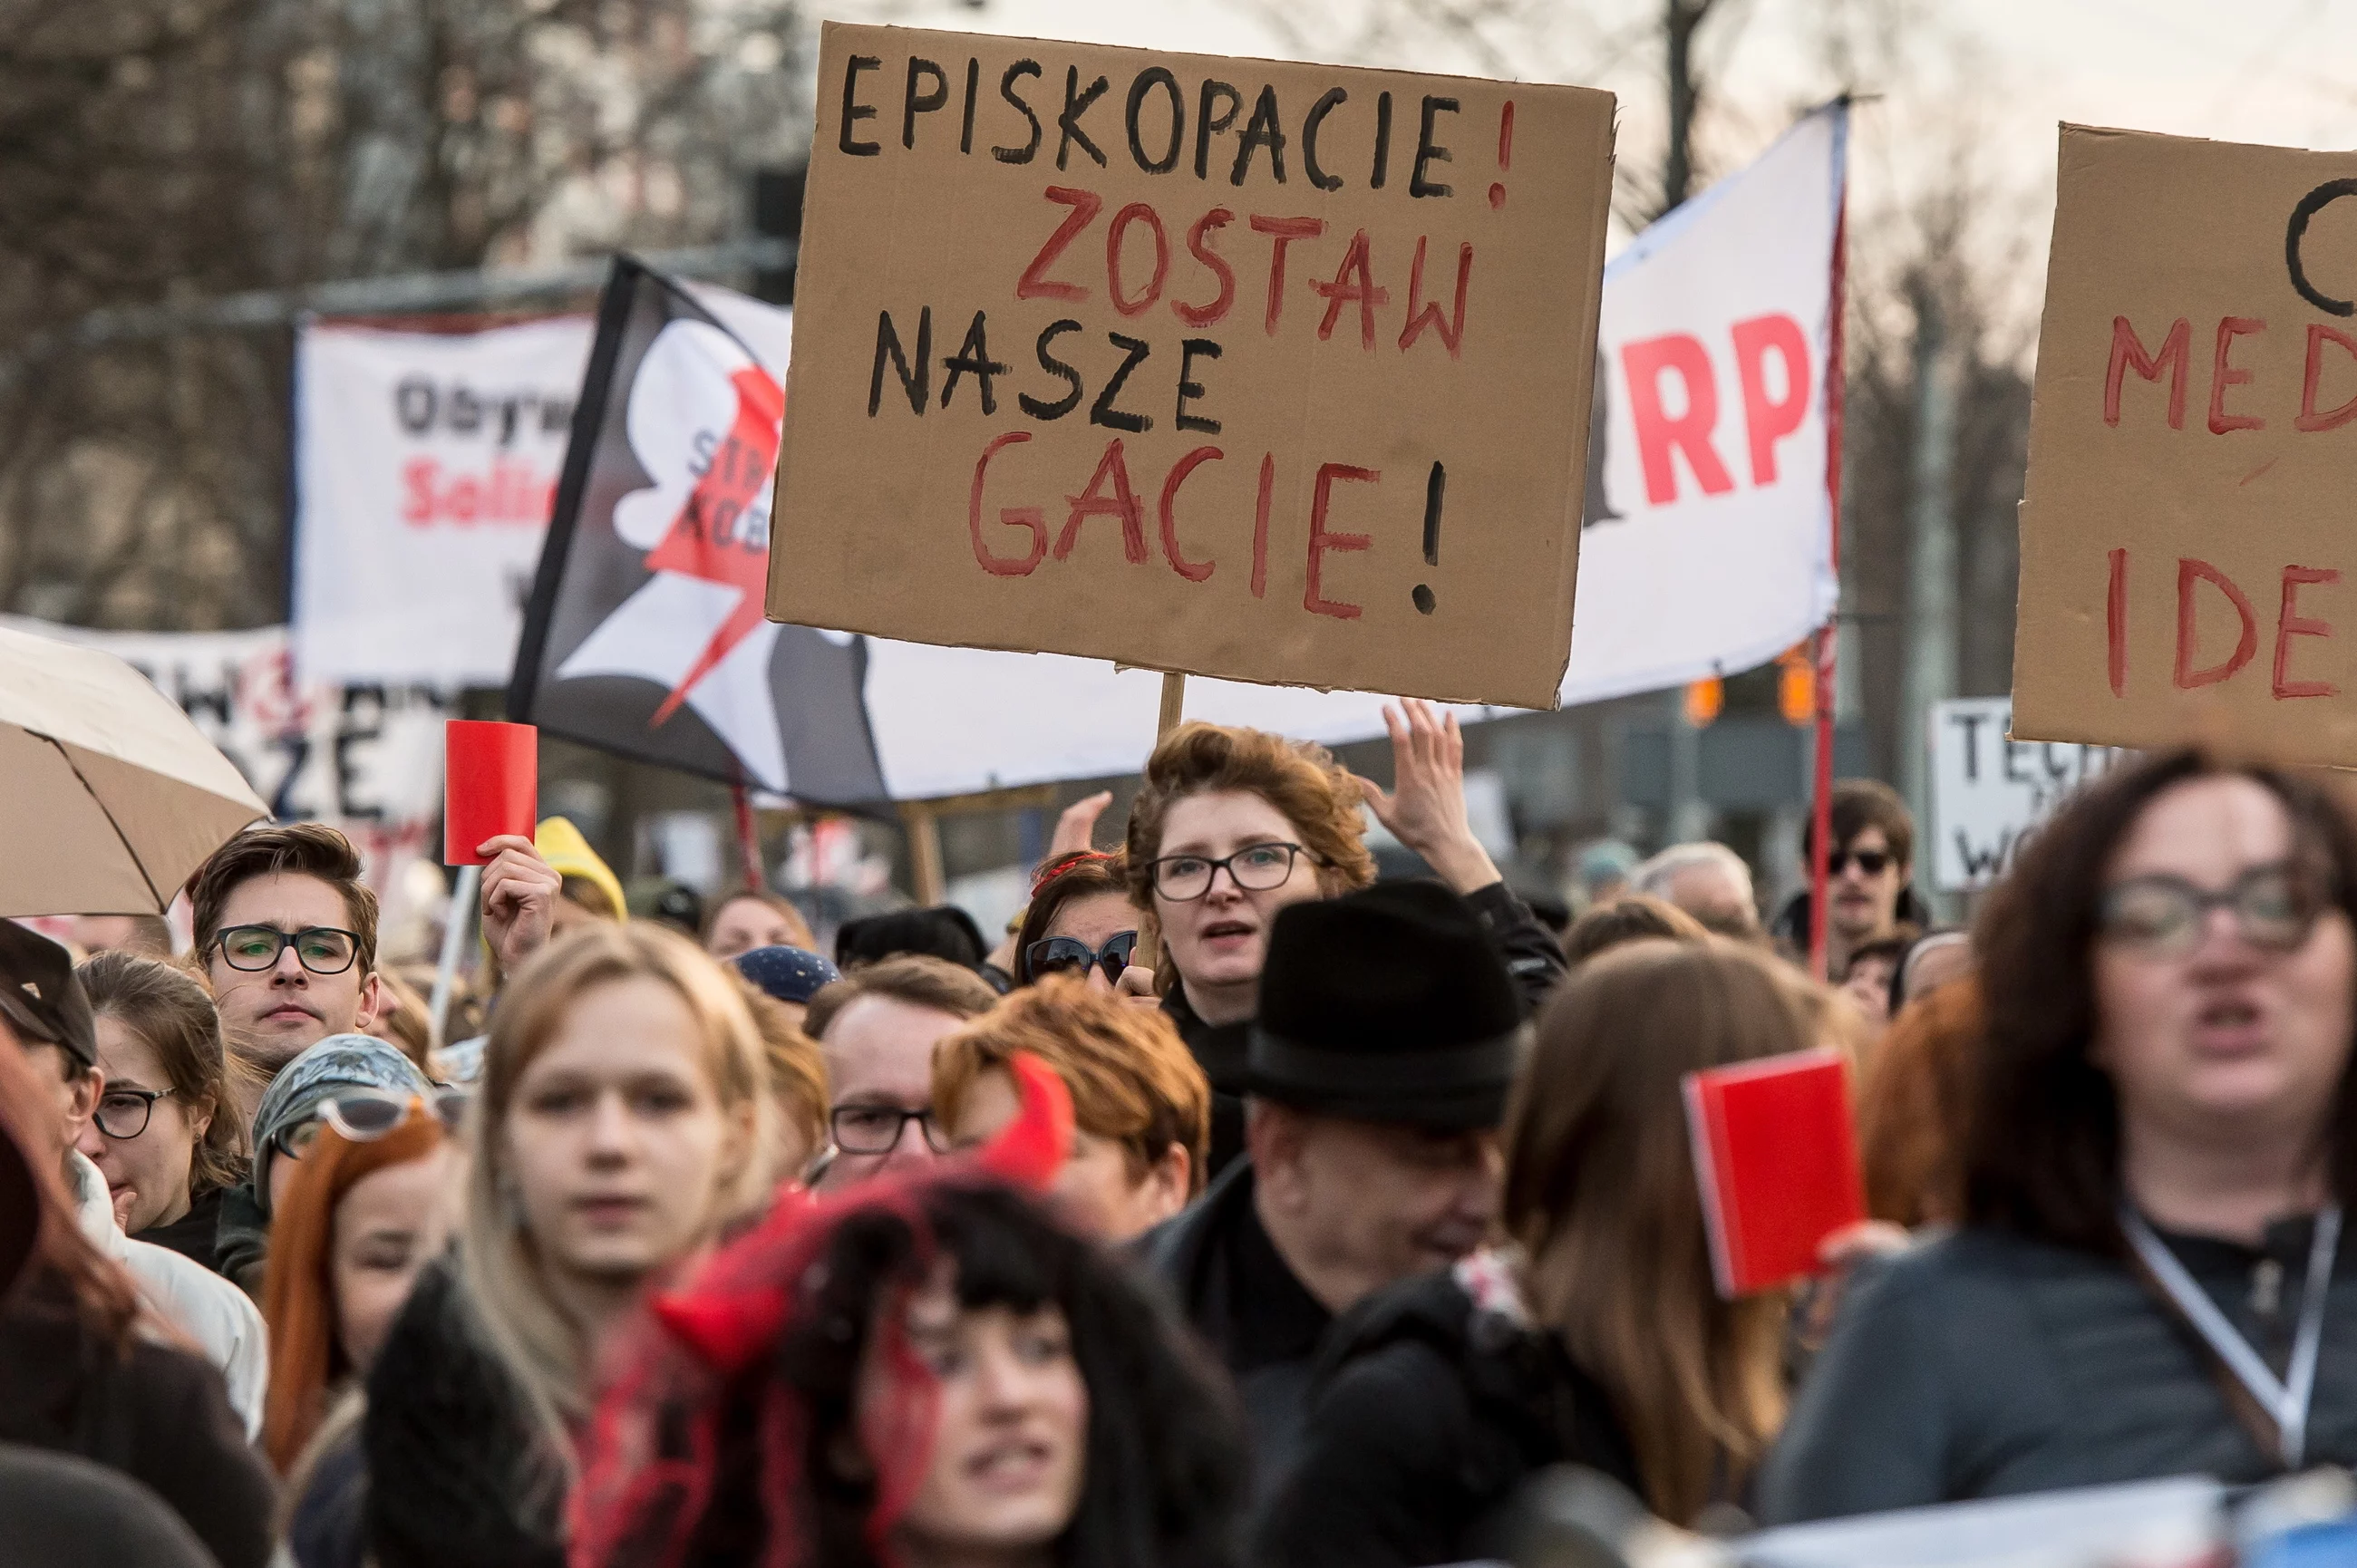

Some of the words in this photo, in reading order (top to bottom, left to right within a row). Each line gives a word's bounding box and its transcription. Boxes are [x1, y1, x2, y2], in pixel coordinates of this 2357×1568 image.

[1017, 185, 1473, 360] ZOSTAW
[868, 305, 1223, 435] NASZE
[1620, 311, 1811, 508] RP
[968, 431, 1445, 620] GACIE!
